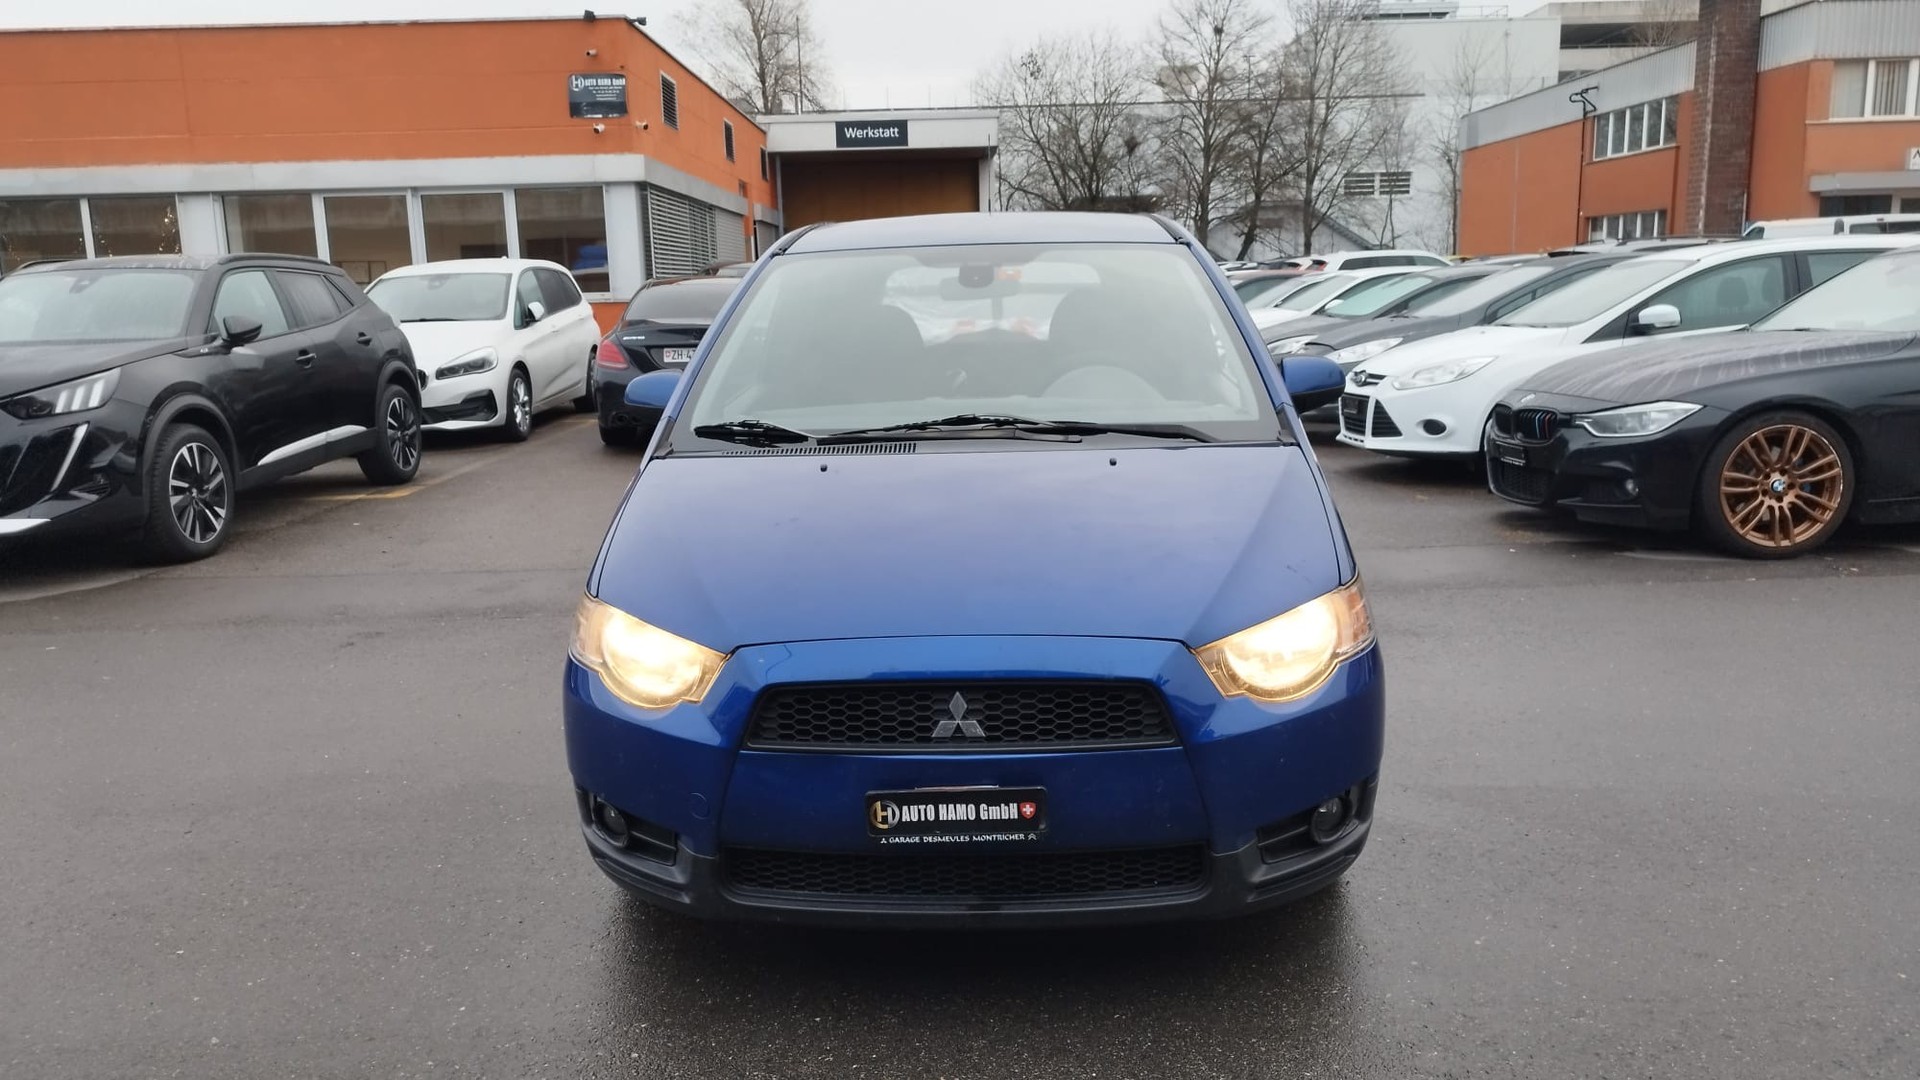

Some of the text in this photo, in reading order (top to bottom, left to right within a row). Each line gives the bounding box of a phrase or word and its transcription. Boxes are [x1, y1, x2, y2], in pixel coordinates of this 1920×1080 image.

[844, 126, 899, 138] Werkstatt
[901, 804, 935, 822] AUTO
[938, 803, 976, 820] HAMO
[980, 803, 1018, 820] GmbH
[889, 833, 1025, 844] GARAGE DESMEULES MONTRICHER
